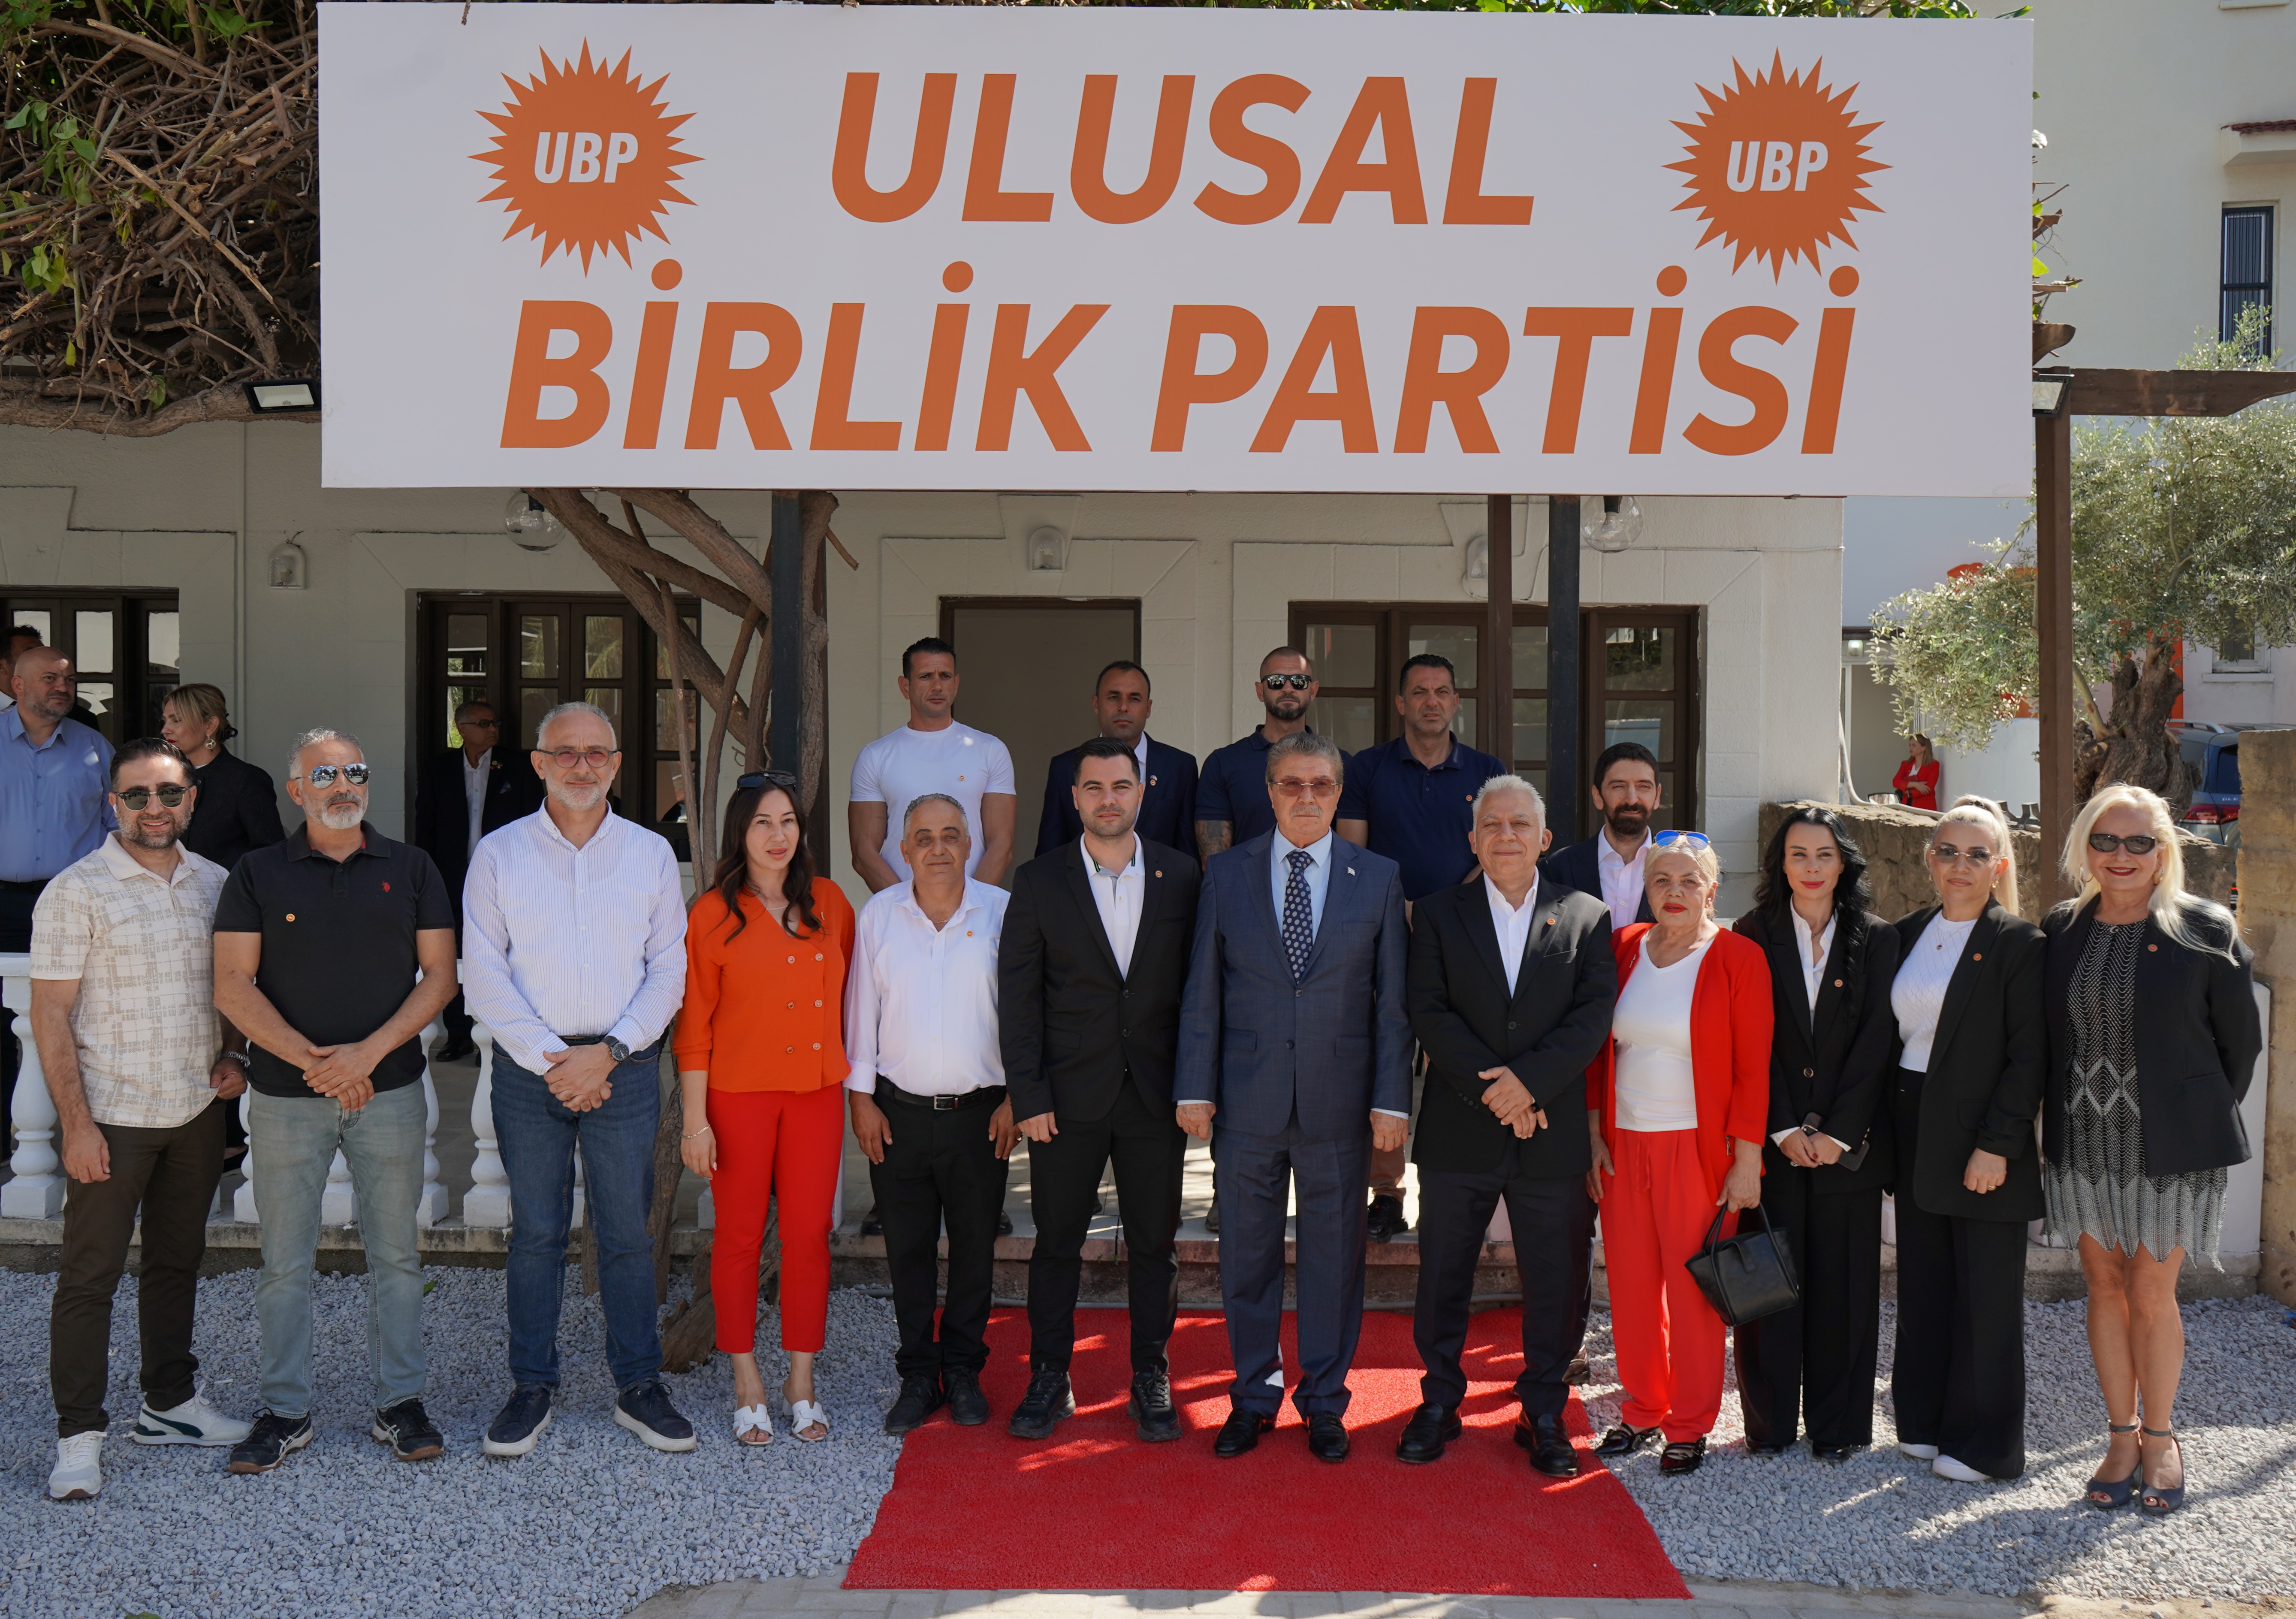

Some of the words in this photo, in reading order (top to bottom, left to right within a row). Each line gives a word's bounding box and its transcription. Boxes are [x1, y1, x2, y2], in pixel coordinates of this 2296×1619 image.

[534, 132, 639, 184] UBP
[833, 72, 1534, 225] ULUSAL
[1726, 141, 1828, 192] UBP
[501, 259, 1111, 451] BİRLİK
[1151, 266, 1859, 456] PARTİSİ
